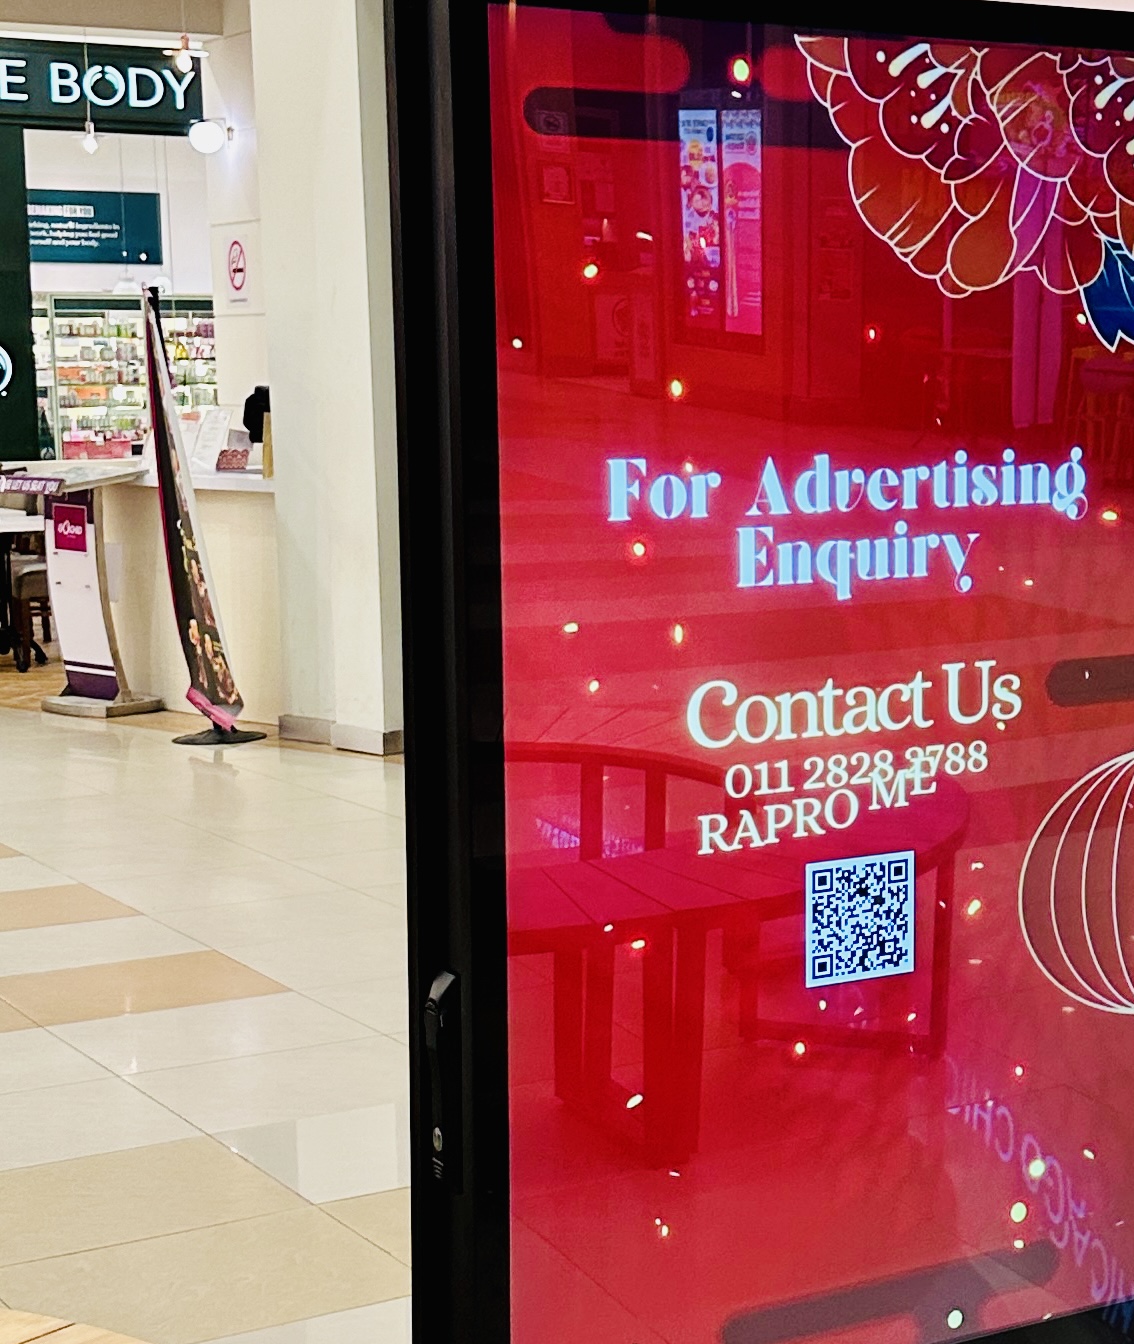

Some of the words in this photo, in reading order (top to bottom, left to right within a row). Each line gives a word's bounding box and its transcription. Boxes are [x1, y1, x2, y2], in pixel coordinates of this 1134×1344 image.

[50, 61, 196, 110] BODY
[606, 455, 722, 522] For
[745, 446, 1088, 520] Advertising
[736, 520, 980, 600] Enquiry
[686, 670, 934, 749] Contact
[941, 659, 1023, 722] Us
[697, 788, 858, 856] RAPRO
[869, 755, 937, 810] ME
[724, 760, 795, 799] 011
[803, 749, 895, 790] 2828
